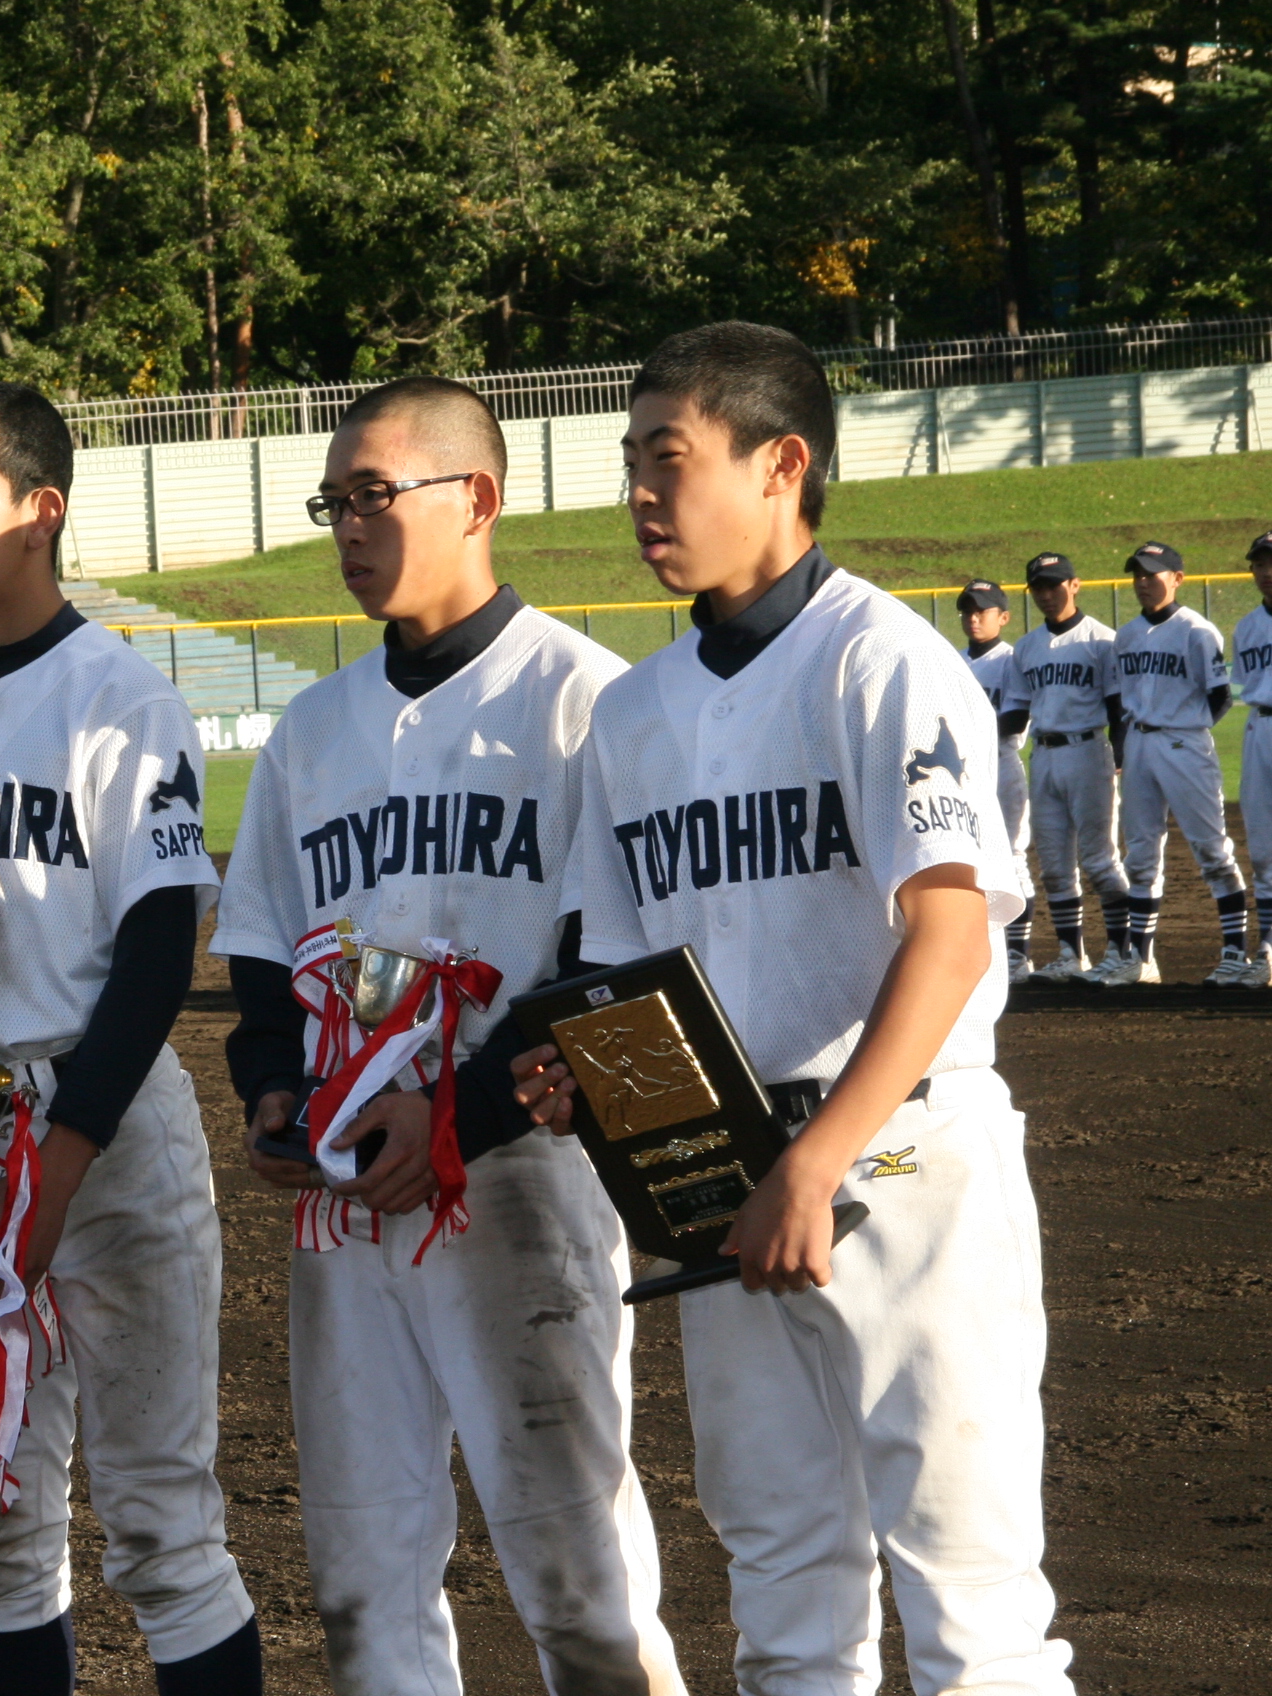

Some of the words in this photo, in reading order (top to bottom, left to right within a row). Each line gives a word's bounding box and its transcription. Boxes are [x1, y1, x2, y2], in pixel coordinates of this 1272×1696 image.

[195, 713, 272, 750] 札幌
[300, 791, 544, 909] TOYOHIRA
[614, 780, 861, 907] TOYOHIRA
